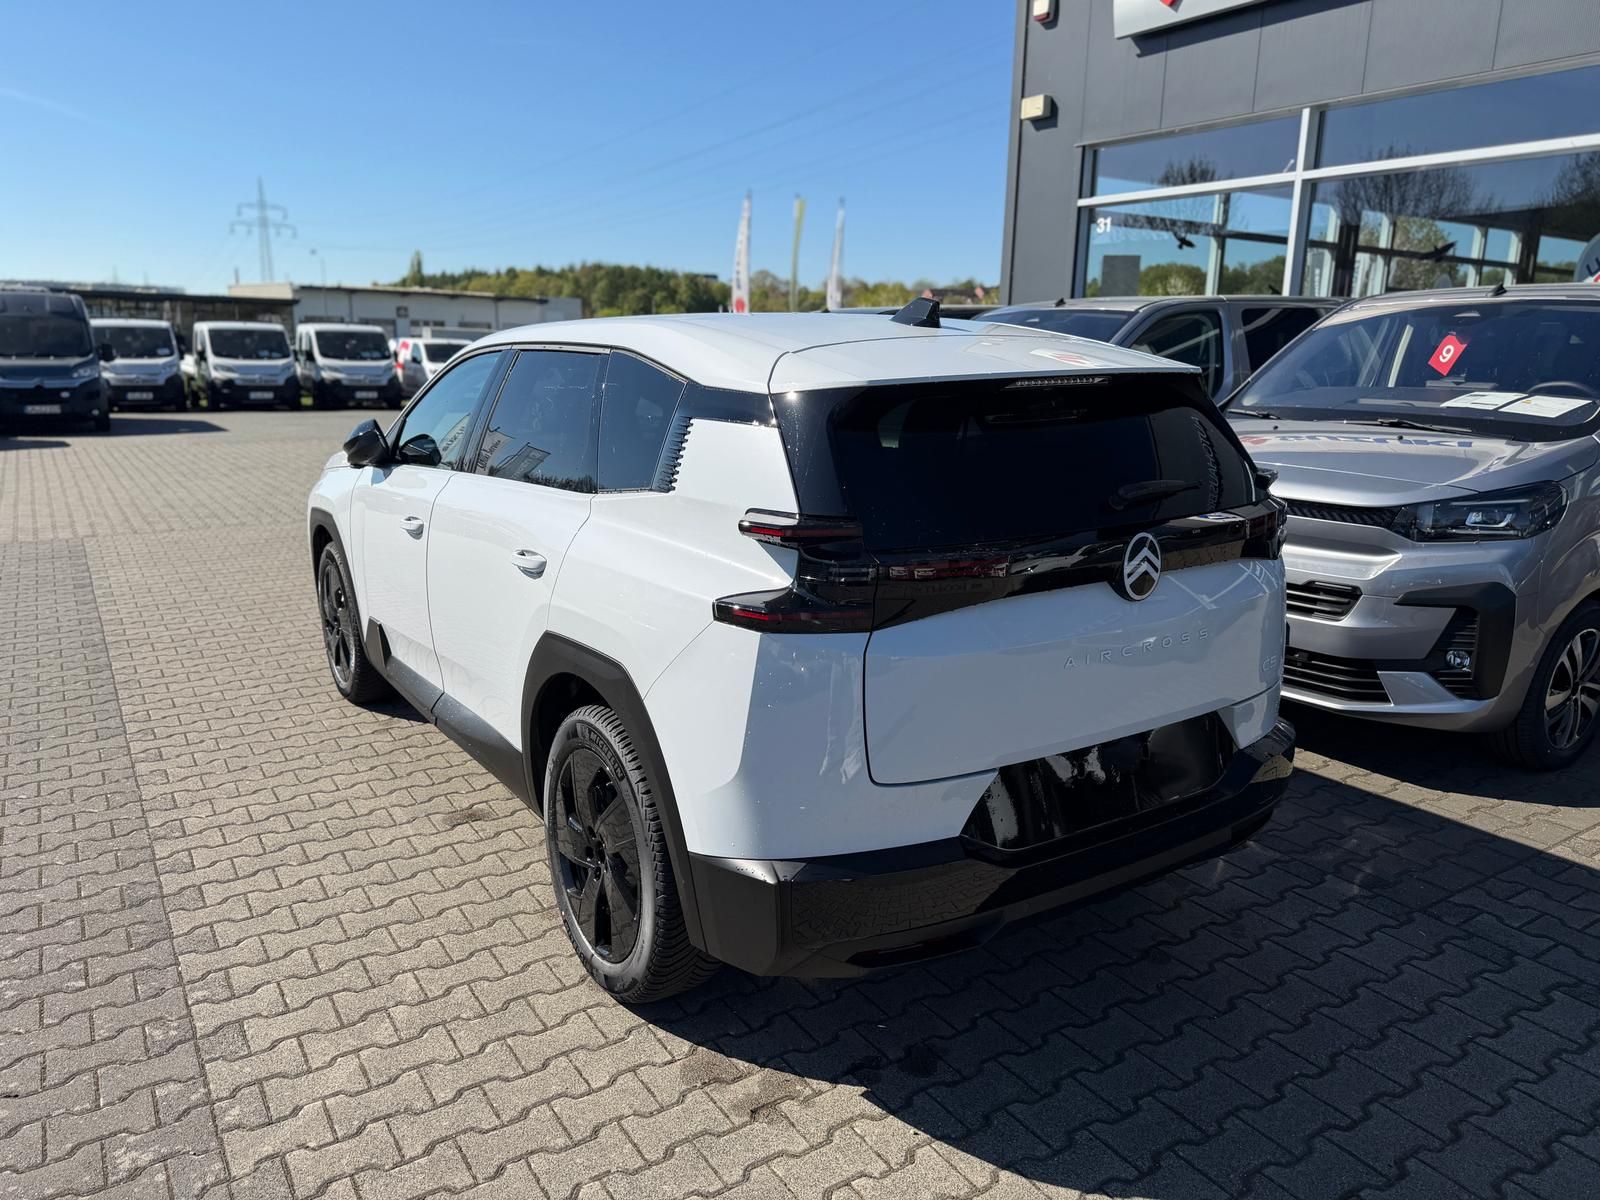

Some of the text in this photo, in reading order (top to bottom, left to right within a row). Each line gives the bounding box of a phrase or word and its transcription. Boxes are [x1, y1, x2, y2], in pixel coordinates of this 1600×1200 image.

[1096, 216, 1112, 234] 31
[1438, 344, 1455, 363] 9
[1063, 628, 1209, 670] AIRCROSS
[590, 731, 624, 778] MICHELIN
